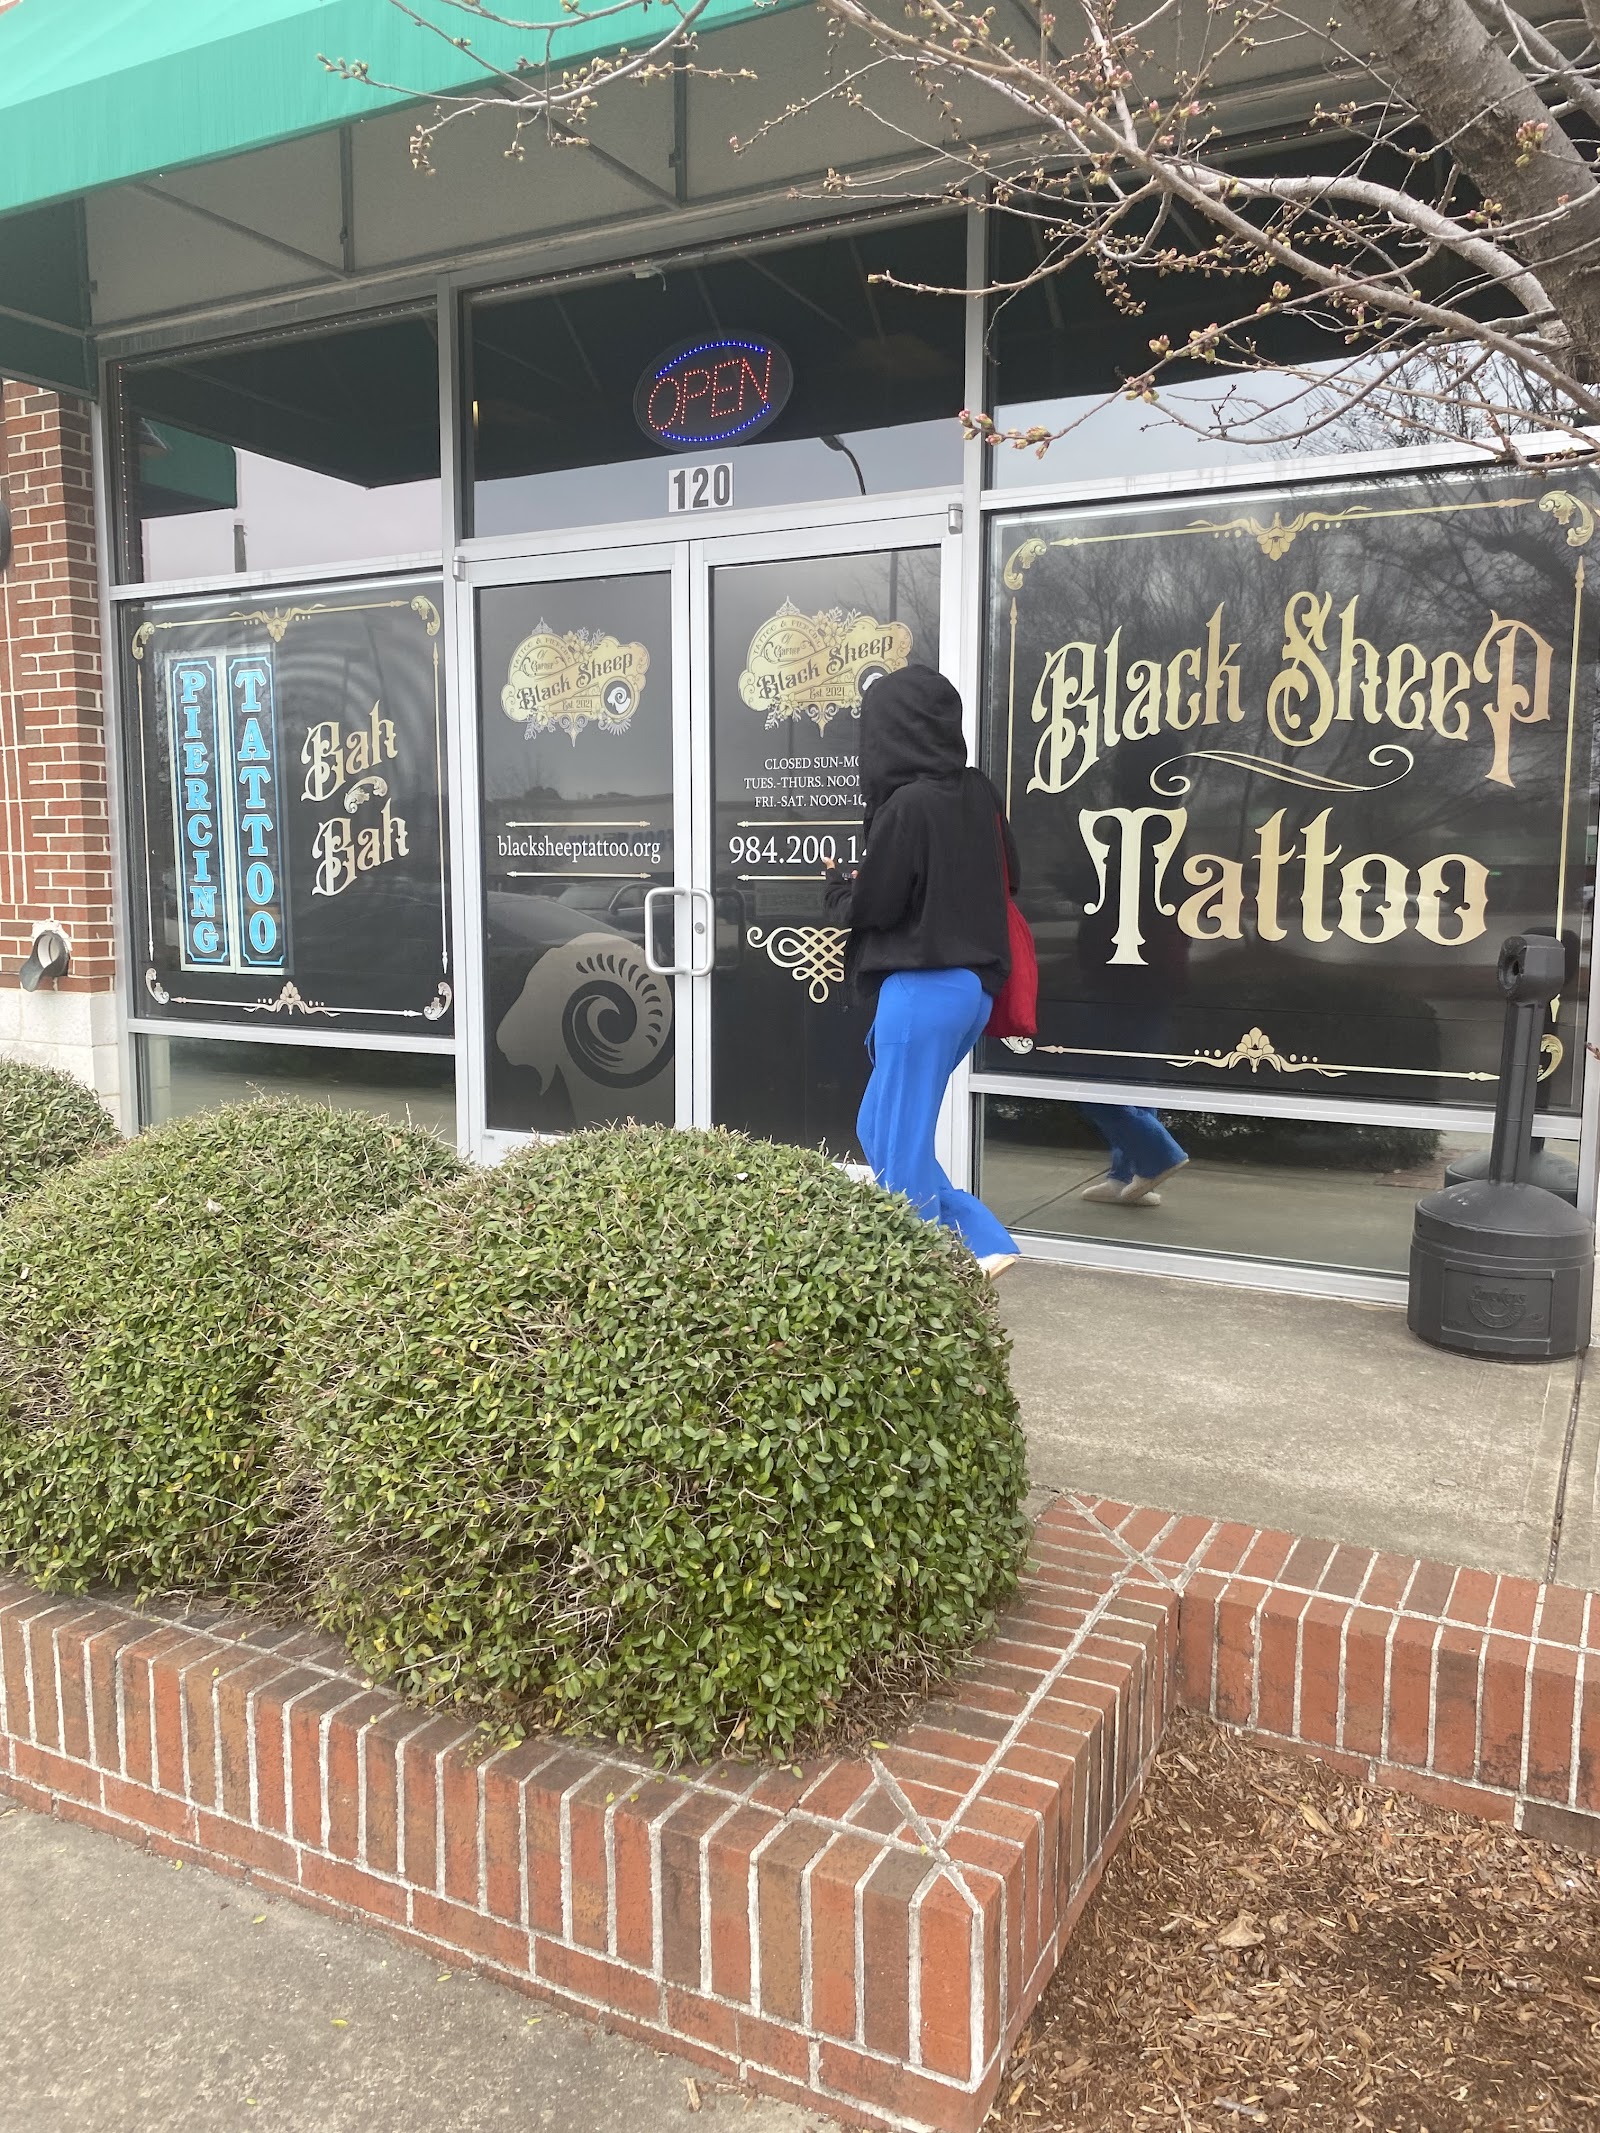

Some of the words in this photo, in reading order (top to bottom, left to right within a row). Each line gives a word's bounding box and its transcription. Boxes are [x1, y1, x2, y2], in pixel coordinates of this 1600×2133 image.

[647, 350, 772, 431] OPEN
[673, 464, 730, 510] 120
[780, 620, 786, 628] &
[516, 673, 571, 709] Black
[576, 653, 633, 688] Sheep
[756, 659, 820, 699] Black
[826, 635, 893, 676] Sheep
[825, 686, 845, 698] 2021
[1026, 601, 1245, 794] Black
[300, 699, 398, 802] Bah
[764, 757, 811, 770] CLOSED
[180, 670, 219, 954] PIERCING
[234, 669, 277, 954] TATTOO
[743, 775, 824, 789] TUES.-THURS.
[755, 795, 807, 808] FRI.-SAT.
[311, 797, 410, 896] Bah
[497, 835, 661, 864] blacksheeptattoo.org
[1078, 806, 1491, 966] Tattoo
